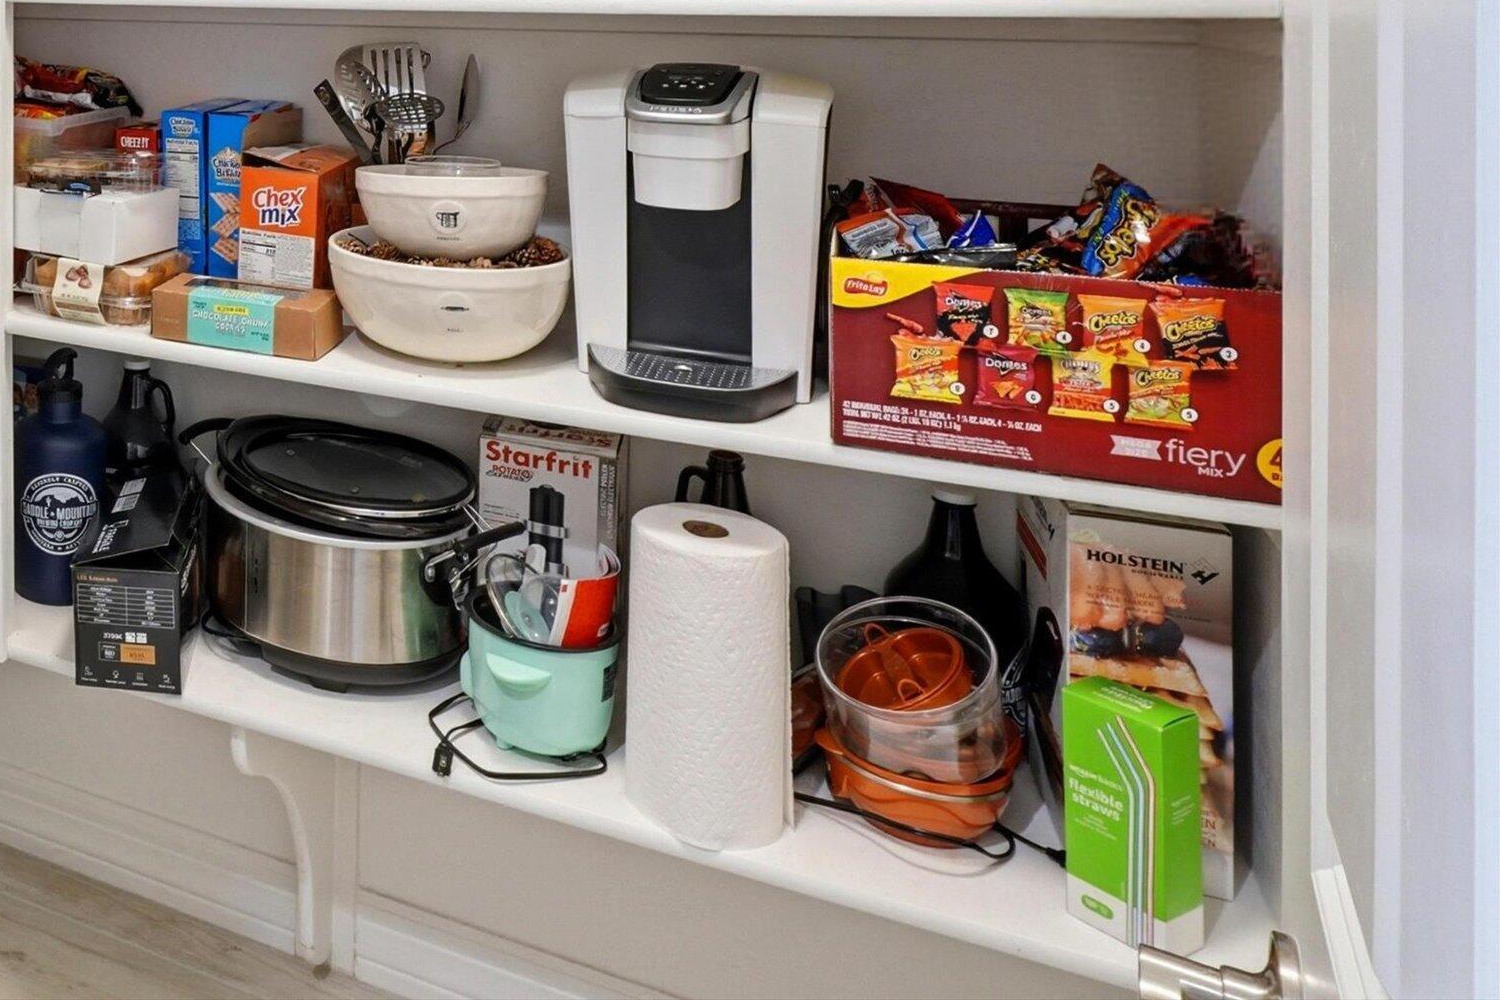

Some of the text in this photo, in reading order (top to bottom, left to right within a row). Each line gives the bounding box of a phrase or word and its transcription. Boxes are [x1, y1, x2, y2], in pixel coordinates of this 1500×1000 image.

[253, 187, 306, 207] Chex
[260, 205, 301, 227] mix
[192, 310, 239, 324] CHOCOLATE
[1089, 311, 1140, 331] Cheetos
[1165, 316, 1217, 342] Cheetos
[985, 358, 1028, 372] Doritos
[1135, 368, 1182, 386] Cheetos
[485, 440, 593, 479] Starfrit
[1165, 438, 1247, 477] fiery
[1197, 466, 1224, 478] MIX
[1086, 549, 1184, 574] HOLSTEIN
[1068, 777, 1125, 812] flexible
[1071, 793, 1121, 822] straws
